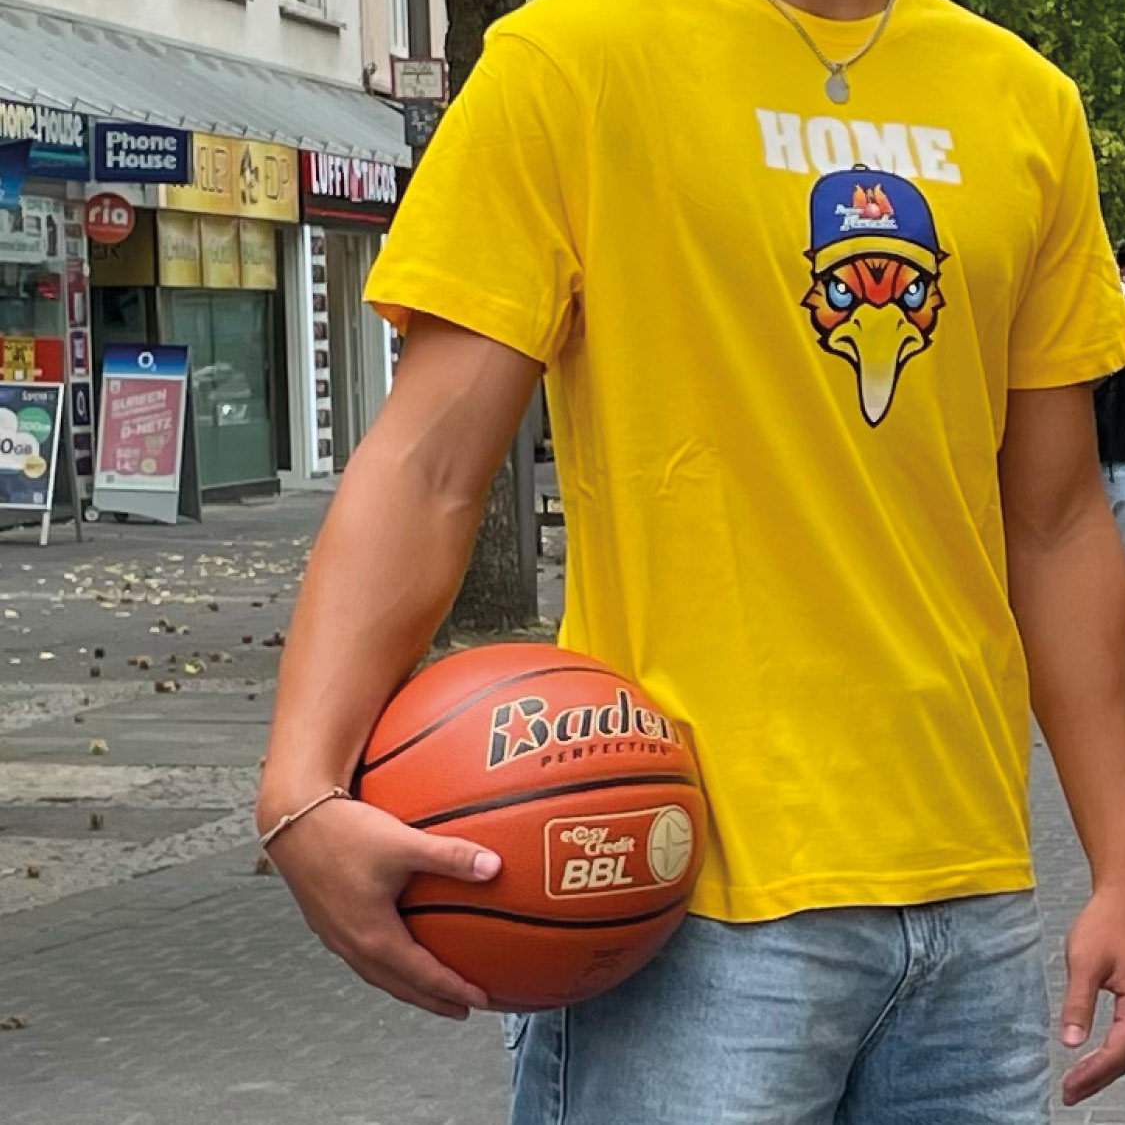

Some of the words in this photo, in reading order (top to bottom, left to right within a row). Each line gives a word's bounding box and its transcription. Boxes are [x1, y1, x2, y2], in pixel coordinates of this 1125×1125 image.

[106, 130, 177, 151] Phone
[755, 107, 963, 186] HOME
[106, 149, 177, 170] House
[88, 197, 129, 226] ria
[561, 855, 634, 891] BBL
